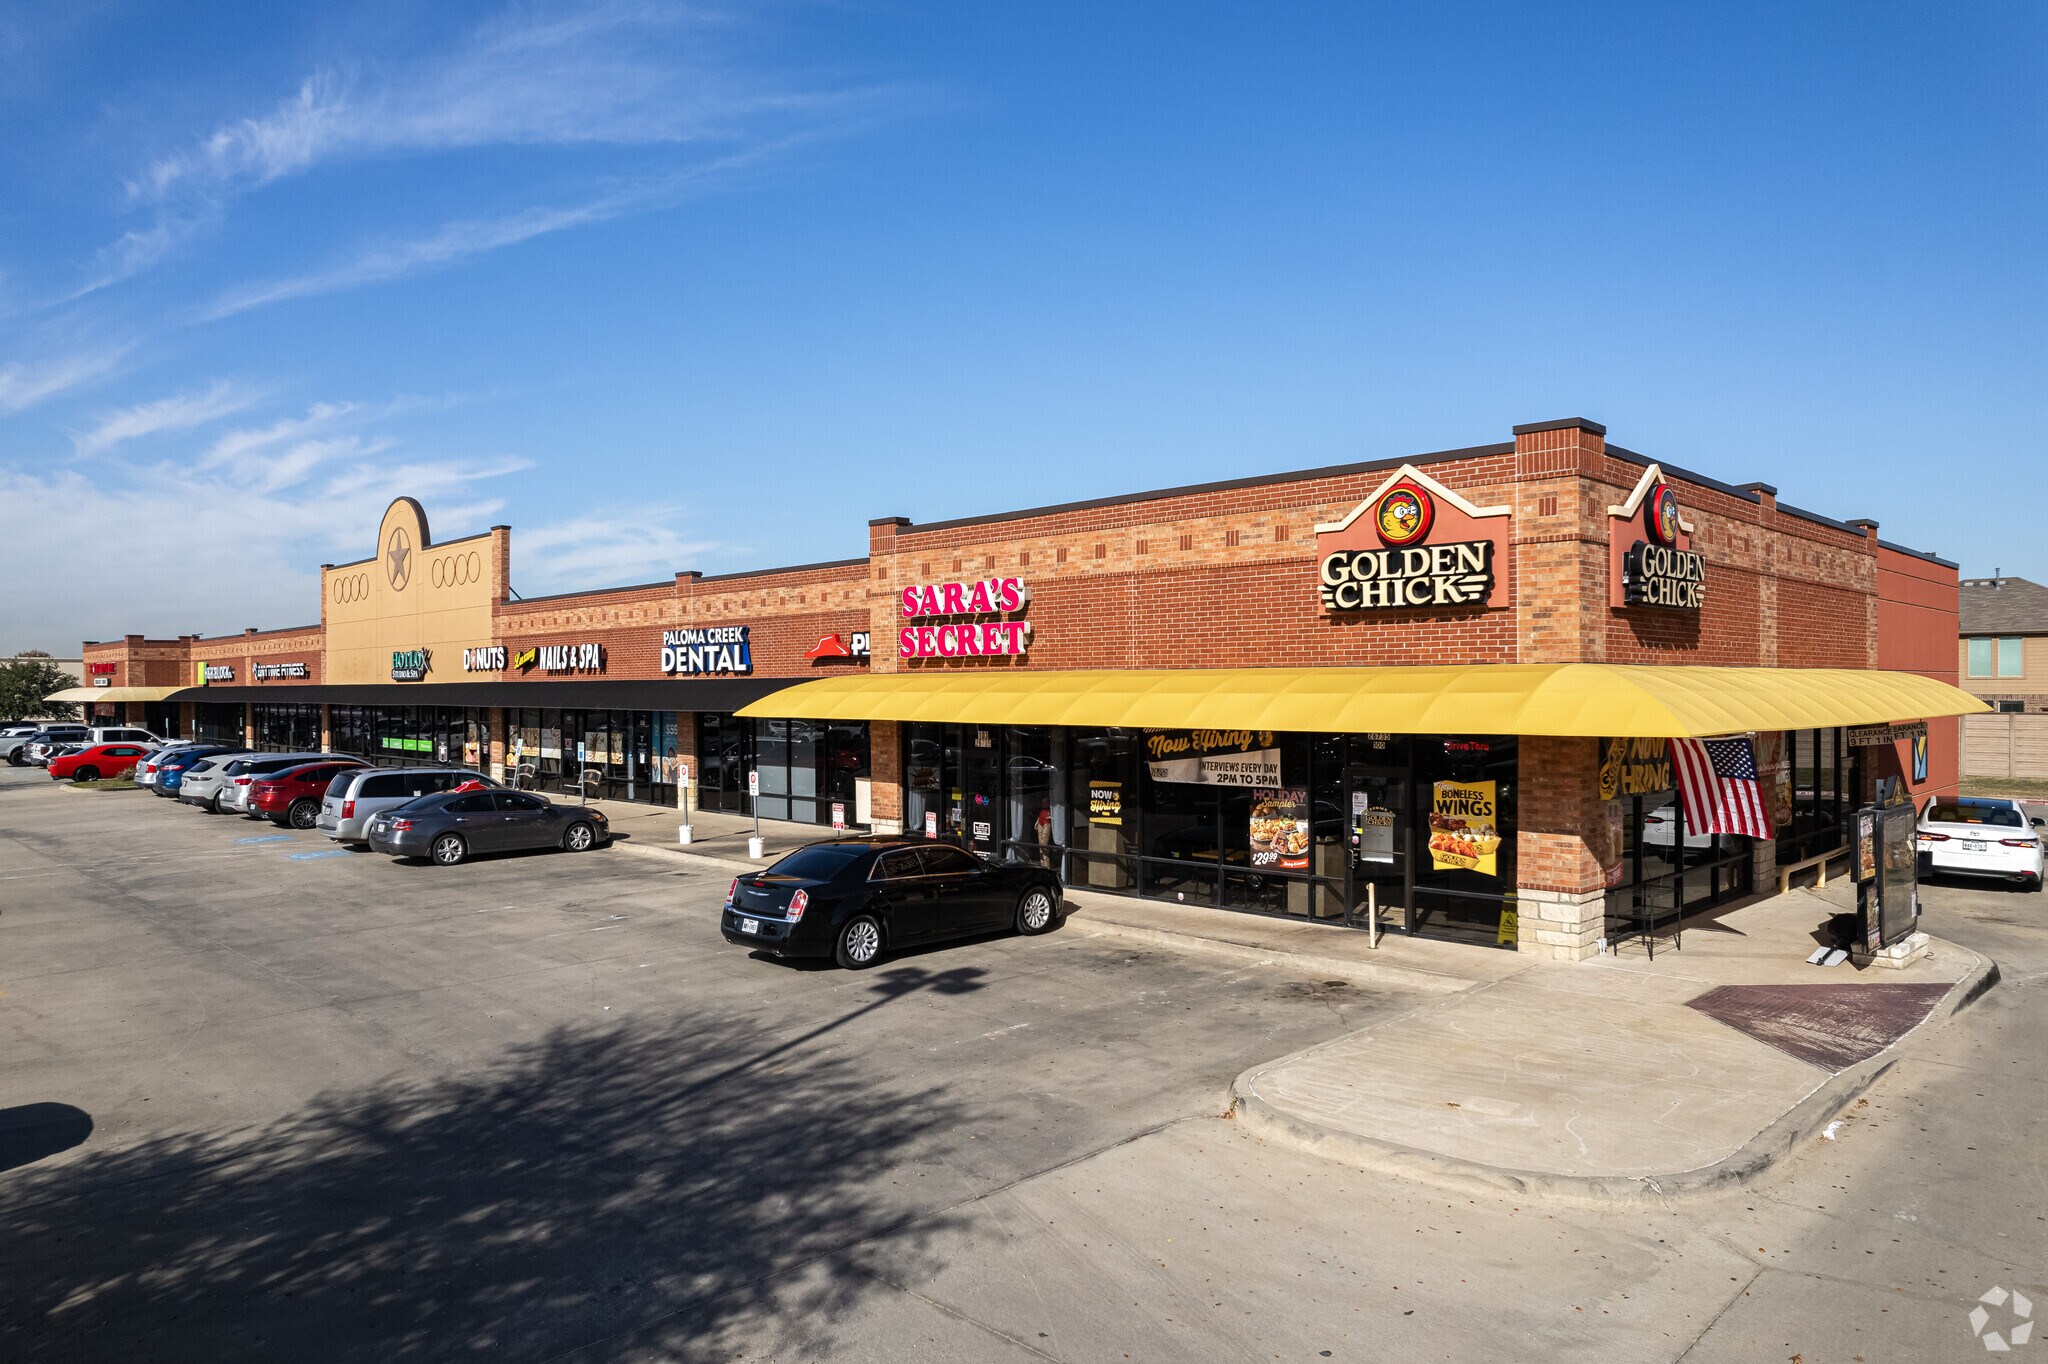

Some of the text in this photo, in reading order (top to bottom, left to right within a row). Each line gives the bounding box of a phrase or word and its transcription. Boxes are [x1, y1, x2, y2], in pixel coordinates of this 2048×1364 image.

[1320, 541, 1489, 584] GOLDEN
[1642, 545, 1706, 583] GOLDEN
[902, 577, 1026, 619] SARA'S
[1337, 576, 1470, 609] CHICK
[1650, 582, 1699, 609] CHICK
[663, 627, 744, 645] PALOMA CREEK
[900, 622, 1027, 660] SECRET
[463, 646, 504, 670] DONUTS
[540, 645, 568, 670] NAILS
[570, 646, 577, 667] &
[579, 643, 599, 669] SPA
[661, 644, 747, 672] DENTAL
[1192, 730, 1253, 752] Hiring
[1850, 728, 1892, 738] CLEARANCE
[1850, 738, 1856, 746] 9
[1860, 737, 1871, 745] FT
[1148, 735, 1190, 758] Now
[1447, 742, 1489, 750] Drive Thru
[1630, 737, 1665, 760] NOW
[1241, 763, 1262, 773] EVERY
[1264, 764, 1278, 773] DAY
[1217, 774, 1279, 785] 2PM TO 5PM
[1091, 790, 1112, 799] NOW
[1253, 789, 1307, 803] HOLIDAY
[1262, 797, 1297, 809] Sampler
[1442, 790, 1484, 800] BONELESS
[1090, 800, 1121, 813] Hiring
[1436, 800, 1493, 816] WINGS
